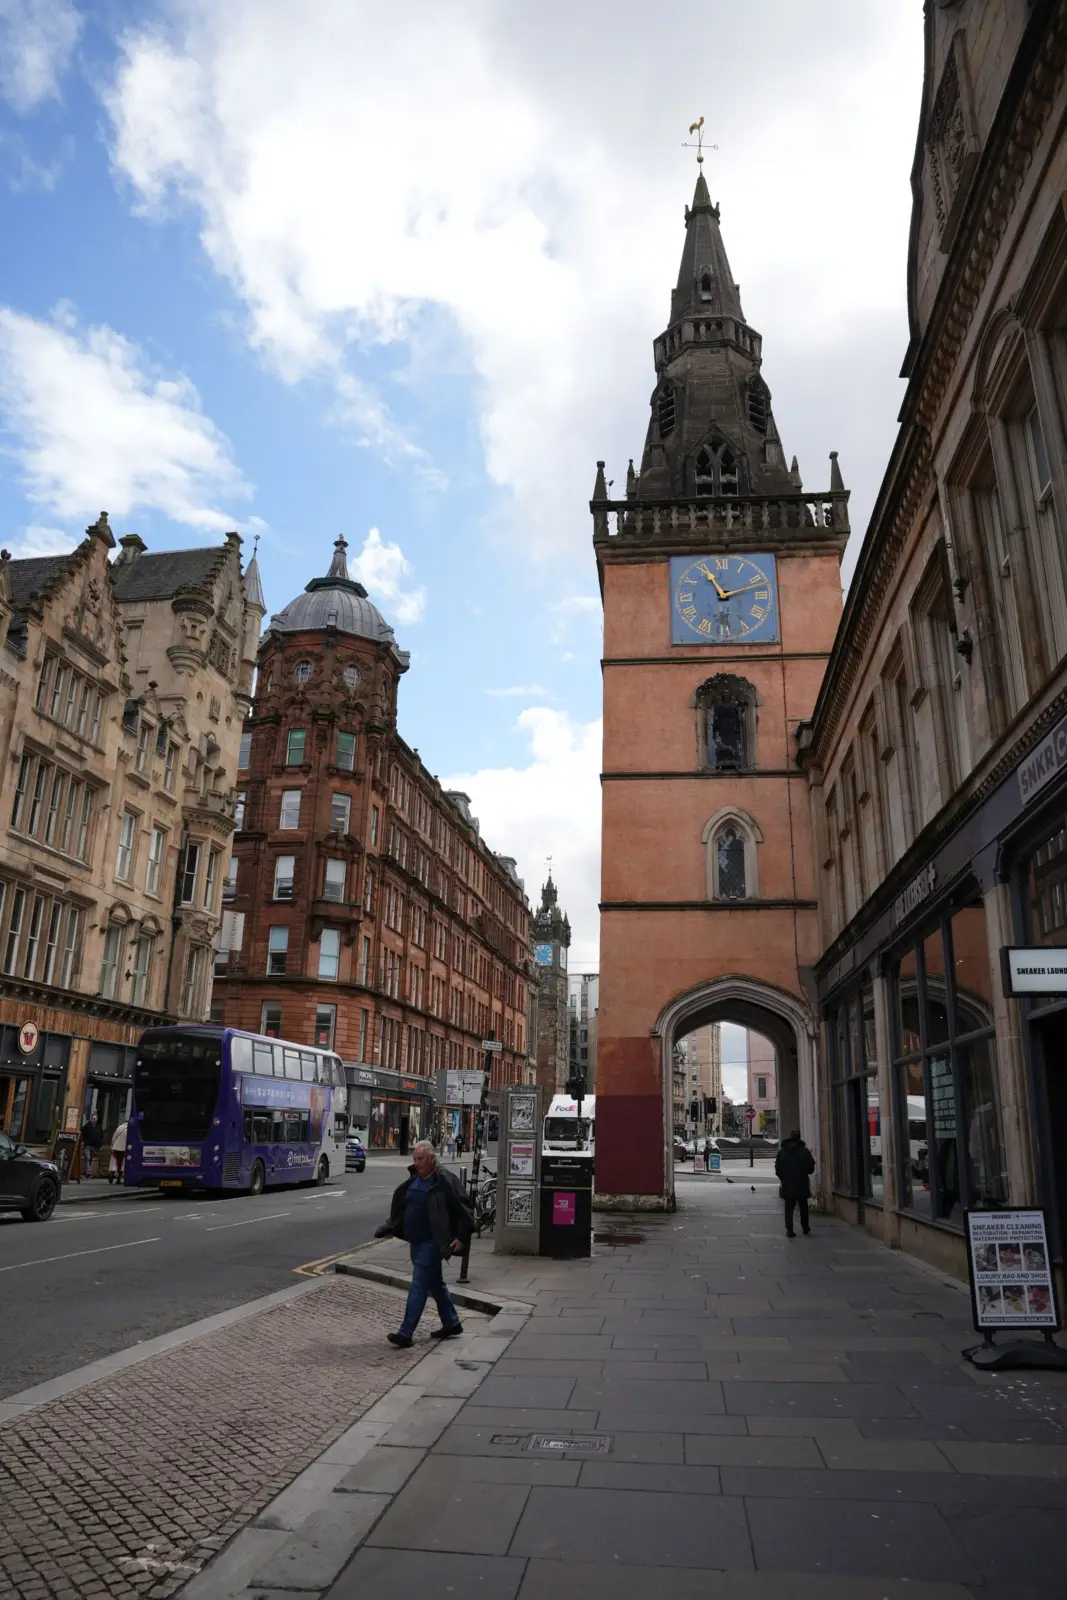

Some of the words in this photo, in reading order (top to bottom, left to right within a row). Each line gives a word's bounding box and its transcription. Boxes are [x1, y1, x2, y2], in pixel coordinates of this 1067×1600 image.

[716, 559, 728, 570] XII
[749, 574, 762, 584] II
[755, 591, 768, 600] III
[1020, 744, 1056, 795] SNKR
[1016, 967, 1046, 975] SNEAKER
[1006, 1223, 1042, 1231] CLEANING
